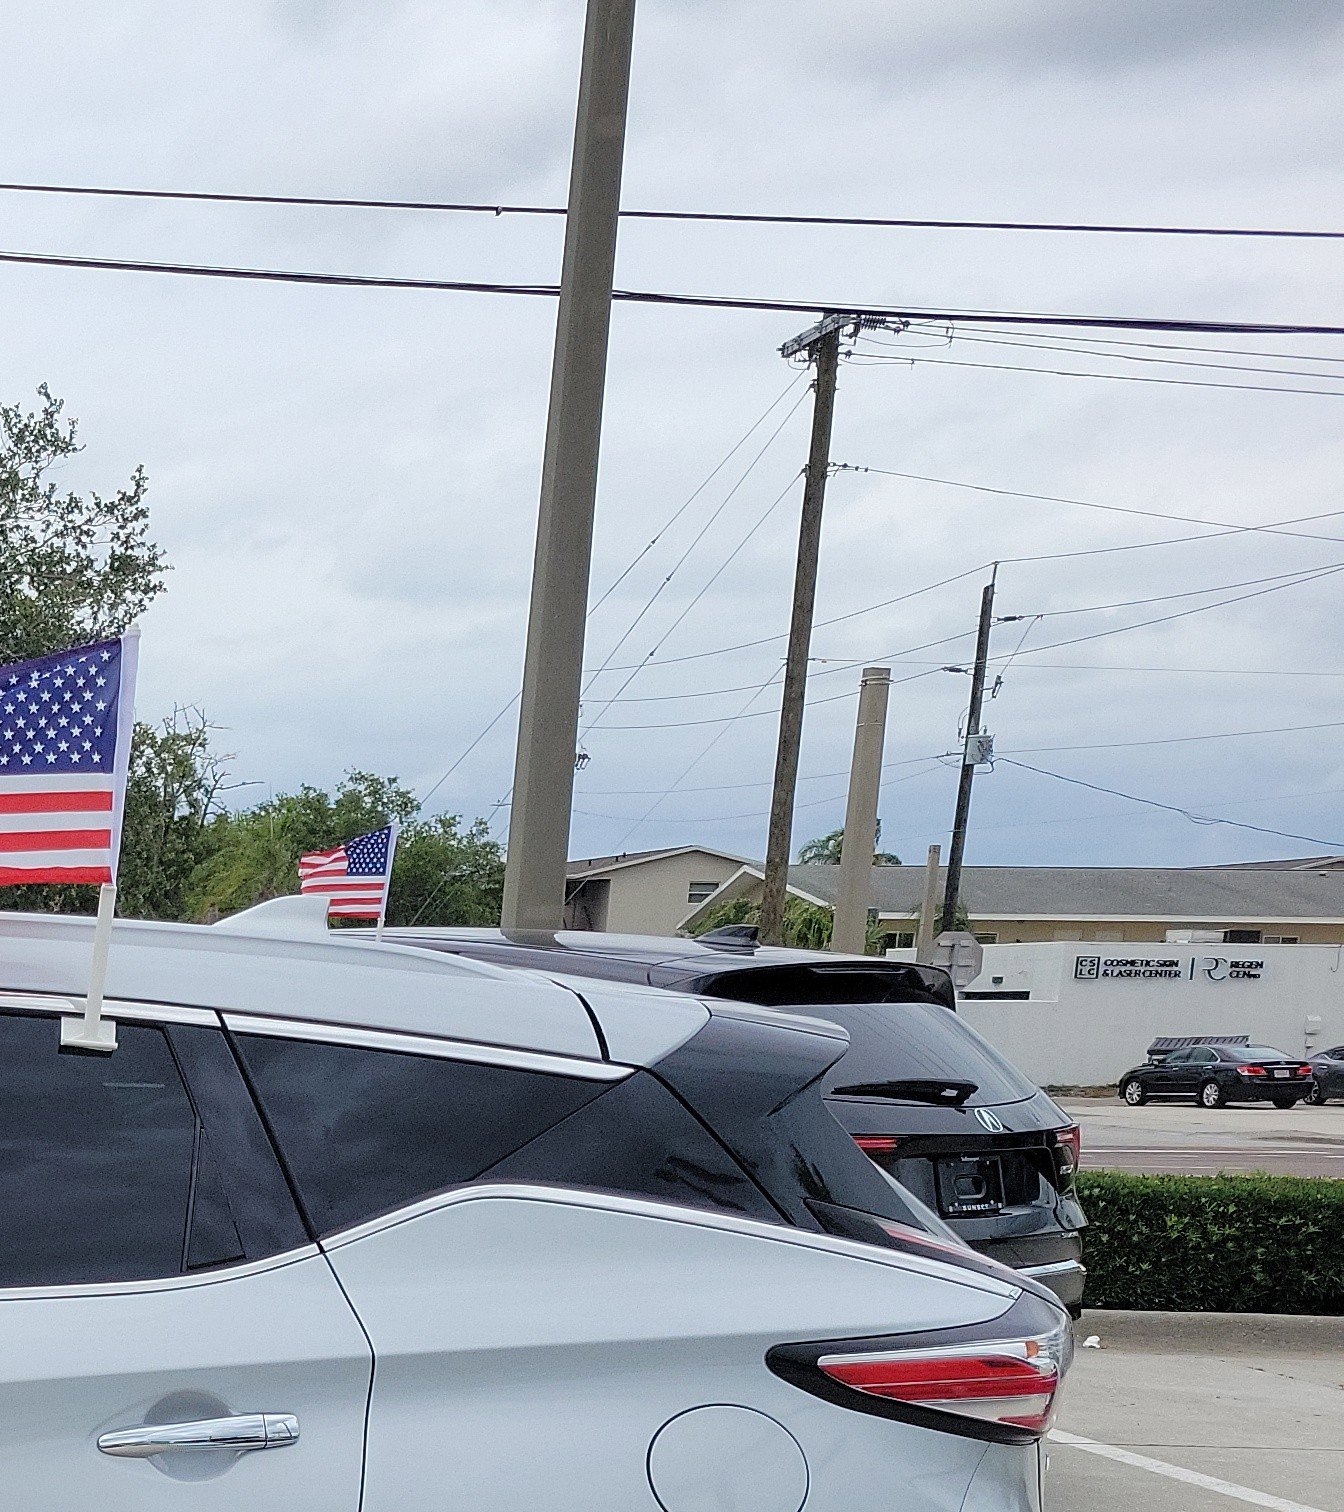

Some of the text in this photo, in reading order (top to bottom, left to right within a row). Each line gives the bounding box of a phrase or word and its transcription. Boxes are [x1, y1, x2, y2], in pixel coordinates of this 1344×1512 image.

[1103, 959, 1155, 968] COSMETIC
[1111, 969, 1141, 978] LASER
[1142, 969, 1182, 978] CENTER
